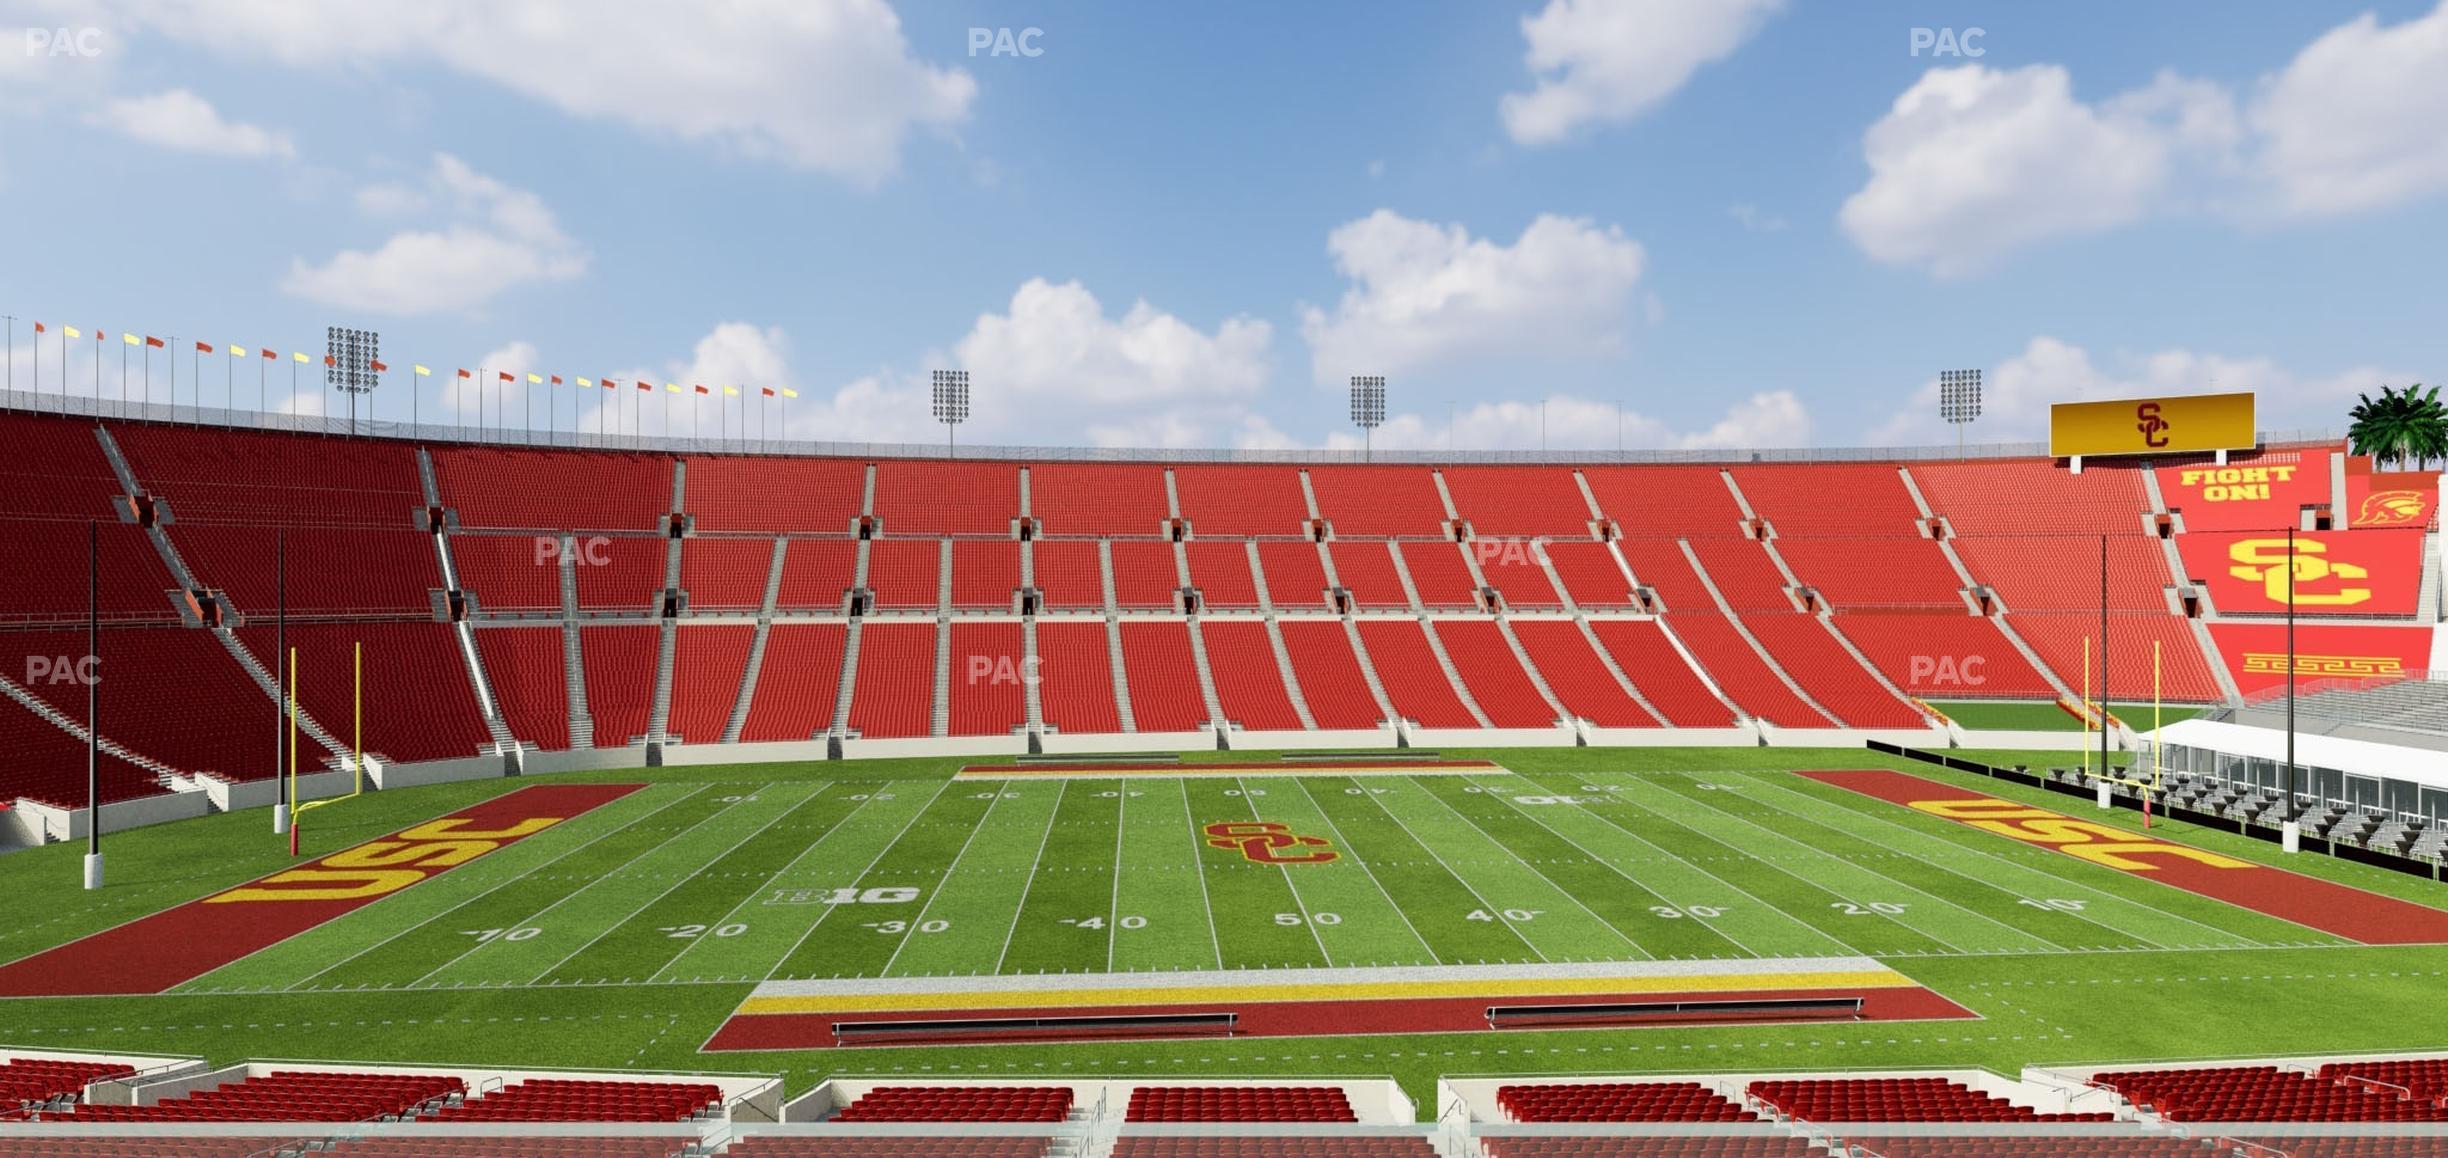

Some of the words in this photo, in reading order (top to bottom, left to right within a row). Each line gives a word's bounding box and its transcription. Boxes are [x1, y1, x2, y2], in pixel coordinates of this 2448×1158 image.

[2137, 402, 2169, 448] SC
[2180, 465, 2296, 486] FIGHT
[2203, 483, 2270, 502] ON!
[1907, 799, 2260, 871] USC
[200, 817, 565, 903] USC
